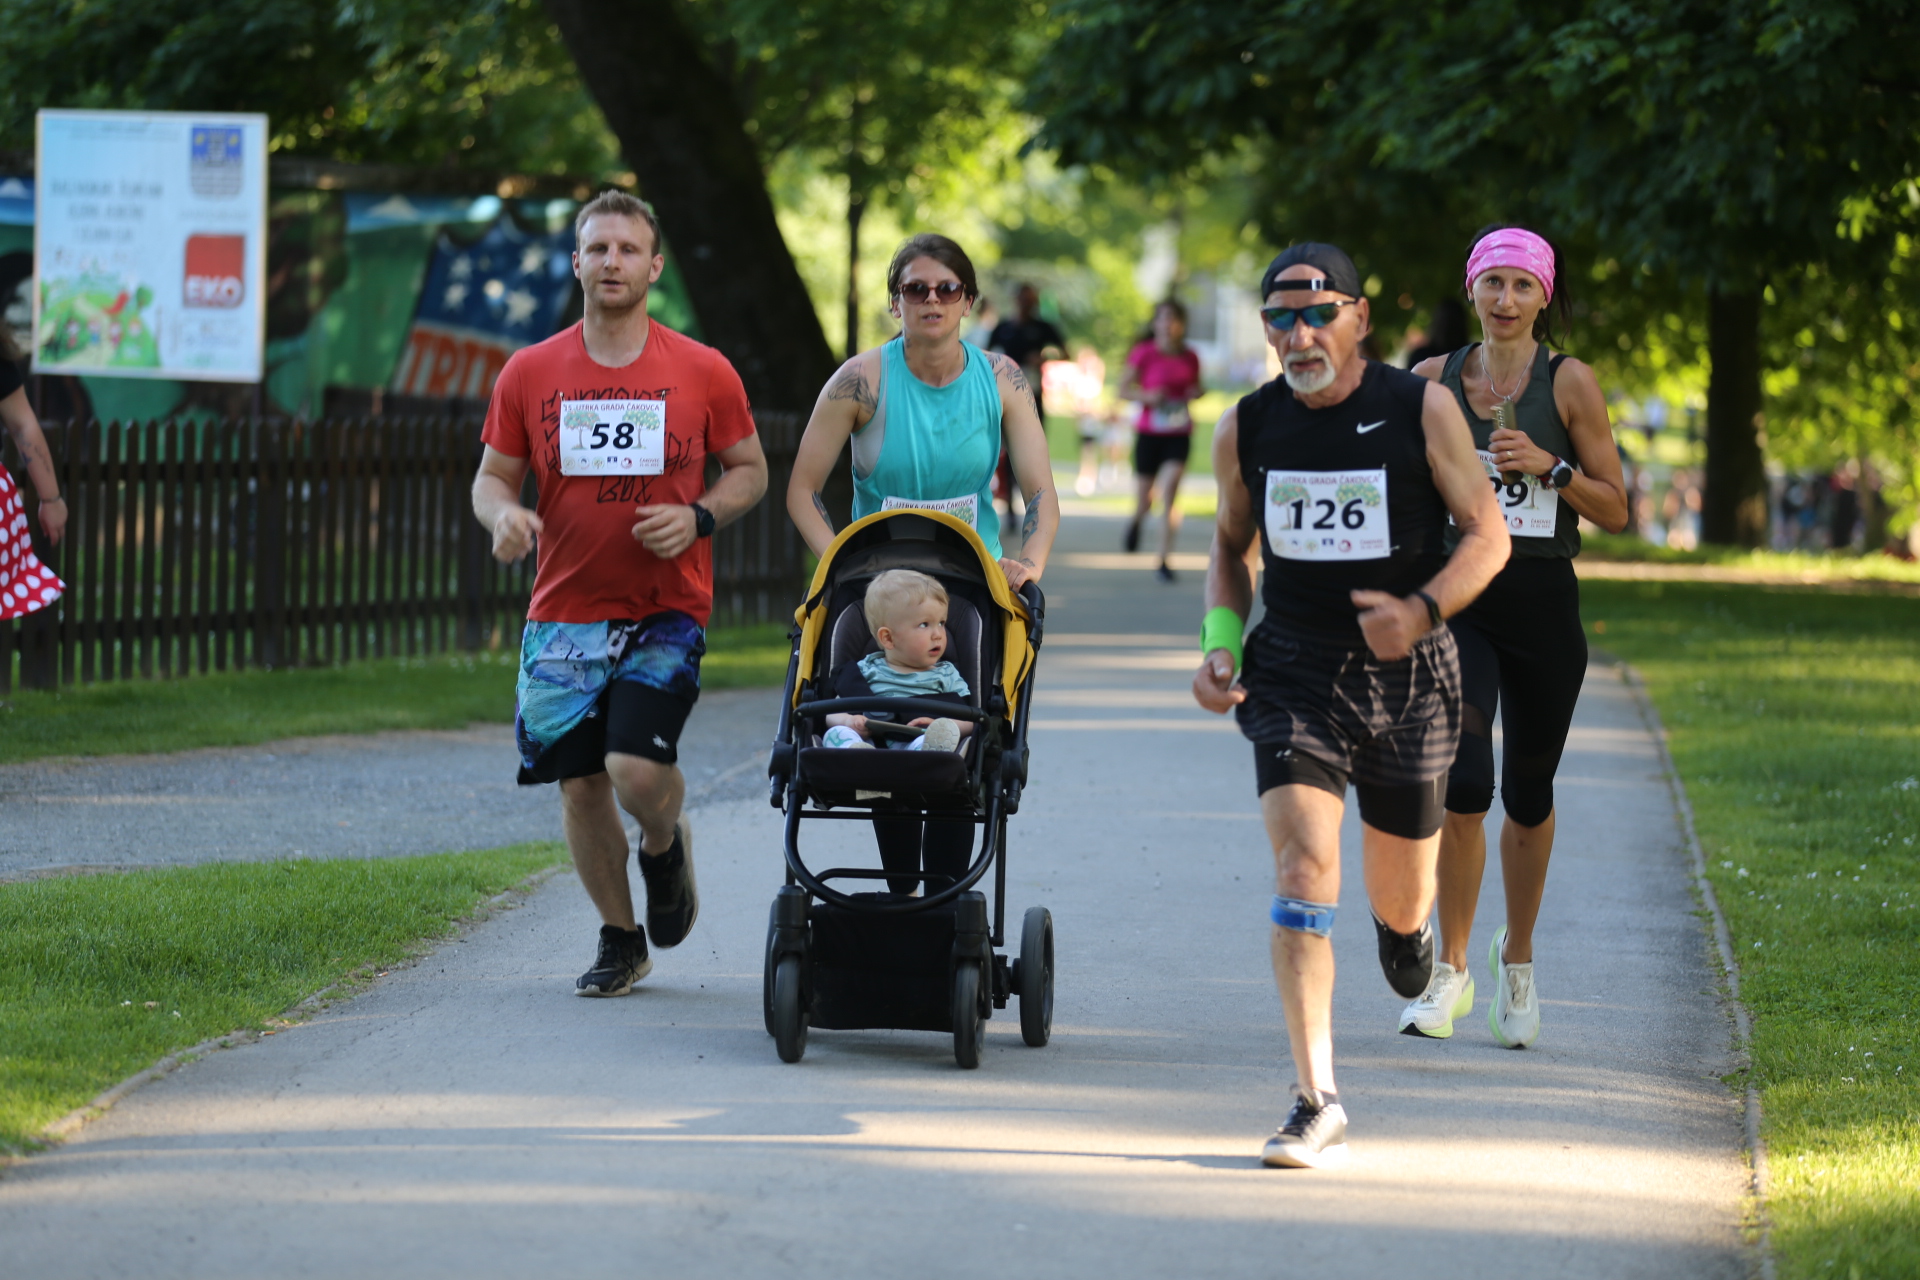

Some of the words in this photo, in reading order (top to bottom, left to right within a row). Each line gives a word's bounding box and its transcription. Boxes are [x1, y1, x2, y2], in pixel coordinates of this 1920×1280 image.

[576, 403, 599, 411] UTRKA
[600, 403, 625, 411] GRADA
[626, 402, 660, 411] ČAKOVCA
[590, 423, 635, 449] 58
[1309, 476, 1337, 485] GRADA
[1290, 498, 1365, 530] 126
